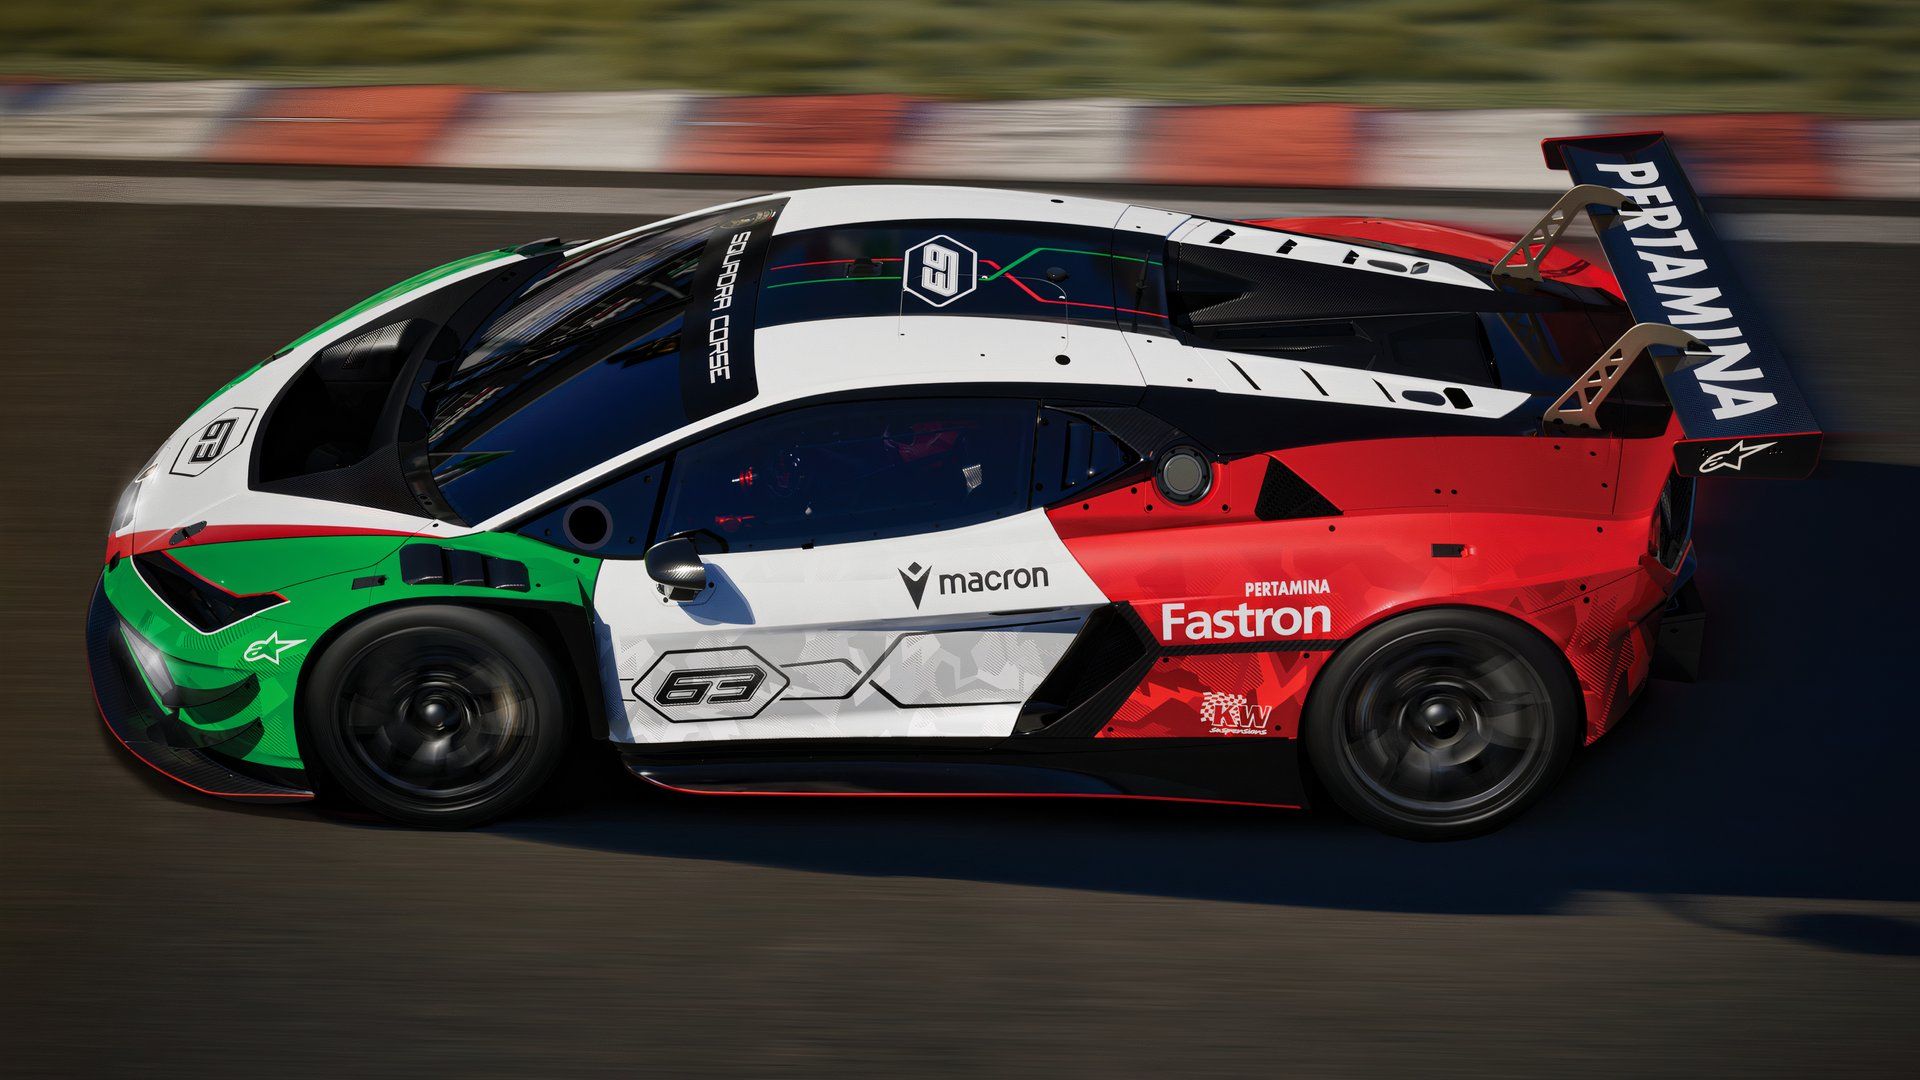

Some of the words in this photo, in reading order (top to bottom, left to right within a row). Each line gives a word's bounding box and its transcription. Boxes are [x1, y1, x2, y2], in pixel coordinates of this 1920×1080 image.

[712, 231, 751, 311] SQUADRA
[922, 243, 959, 297] 63
[1596, 161, 1778, 420] PERTAMINA
[709, 315, 730, 383] CORSE
[188, 417, 239, 464] 63
[939, 566, 1049, 595] macron
[1245, 579, 1331, 597] PERTAMINA
[1161, 602, 1332, 641] Fastron
[653, 665, 768, 707] 63
[1211, 704, 1272, 728] KW
